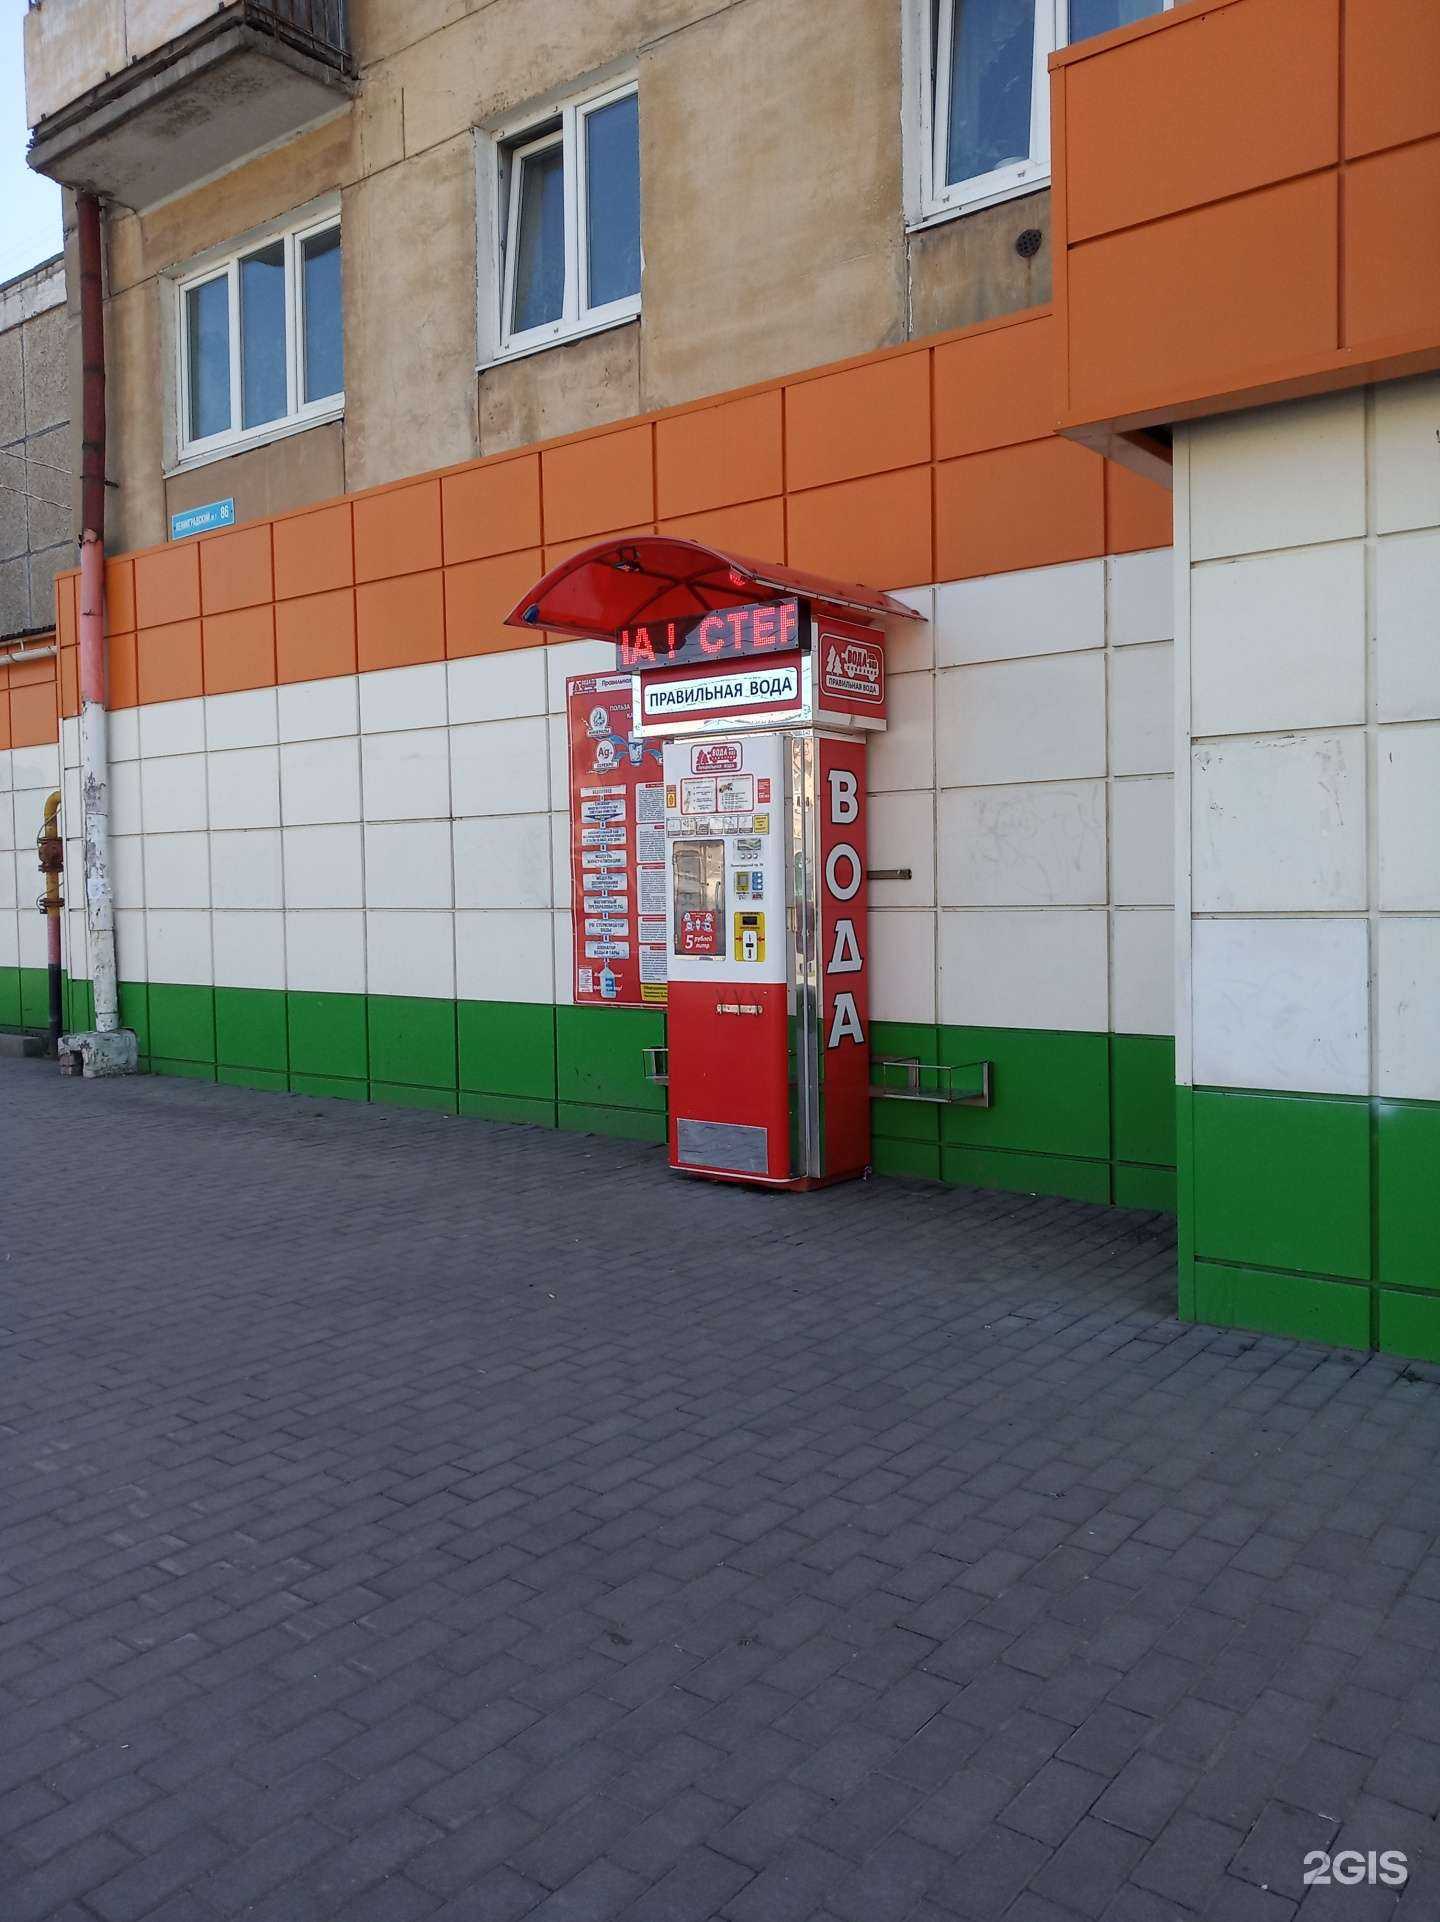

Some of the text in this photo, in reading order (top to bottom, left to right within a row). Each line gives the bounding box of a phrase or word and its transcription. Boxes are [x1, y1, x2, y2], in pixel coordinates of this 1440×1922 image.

[649, 676, 793, 708] ПРАВИЛЬНАЯ ВОДА
[825, 769, 864, 1048] ВОДА
[685, 934, 694, 949] 5
